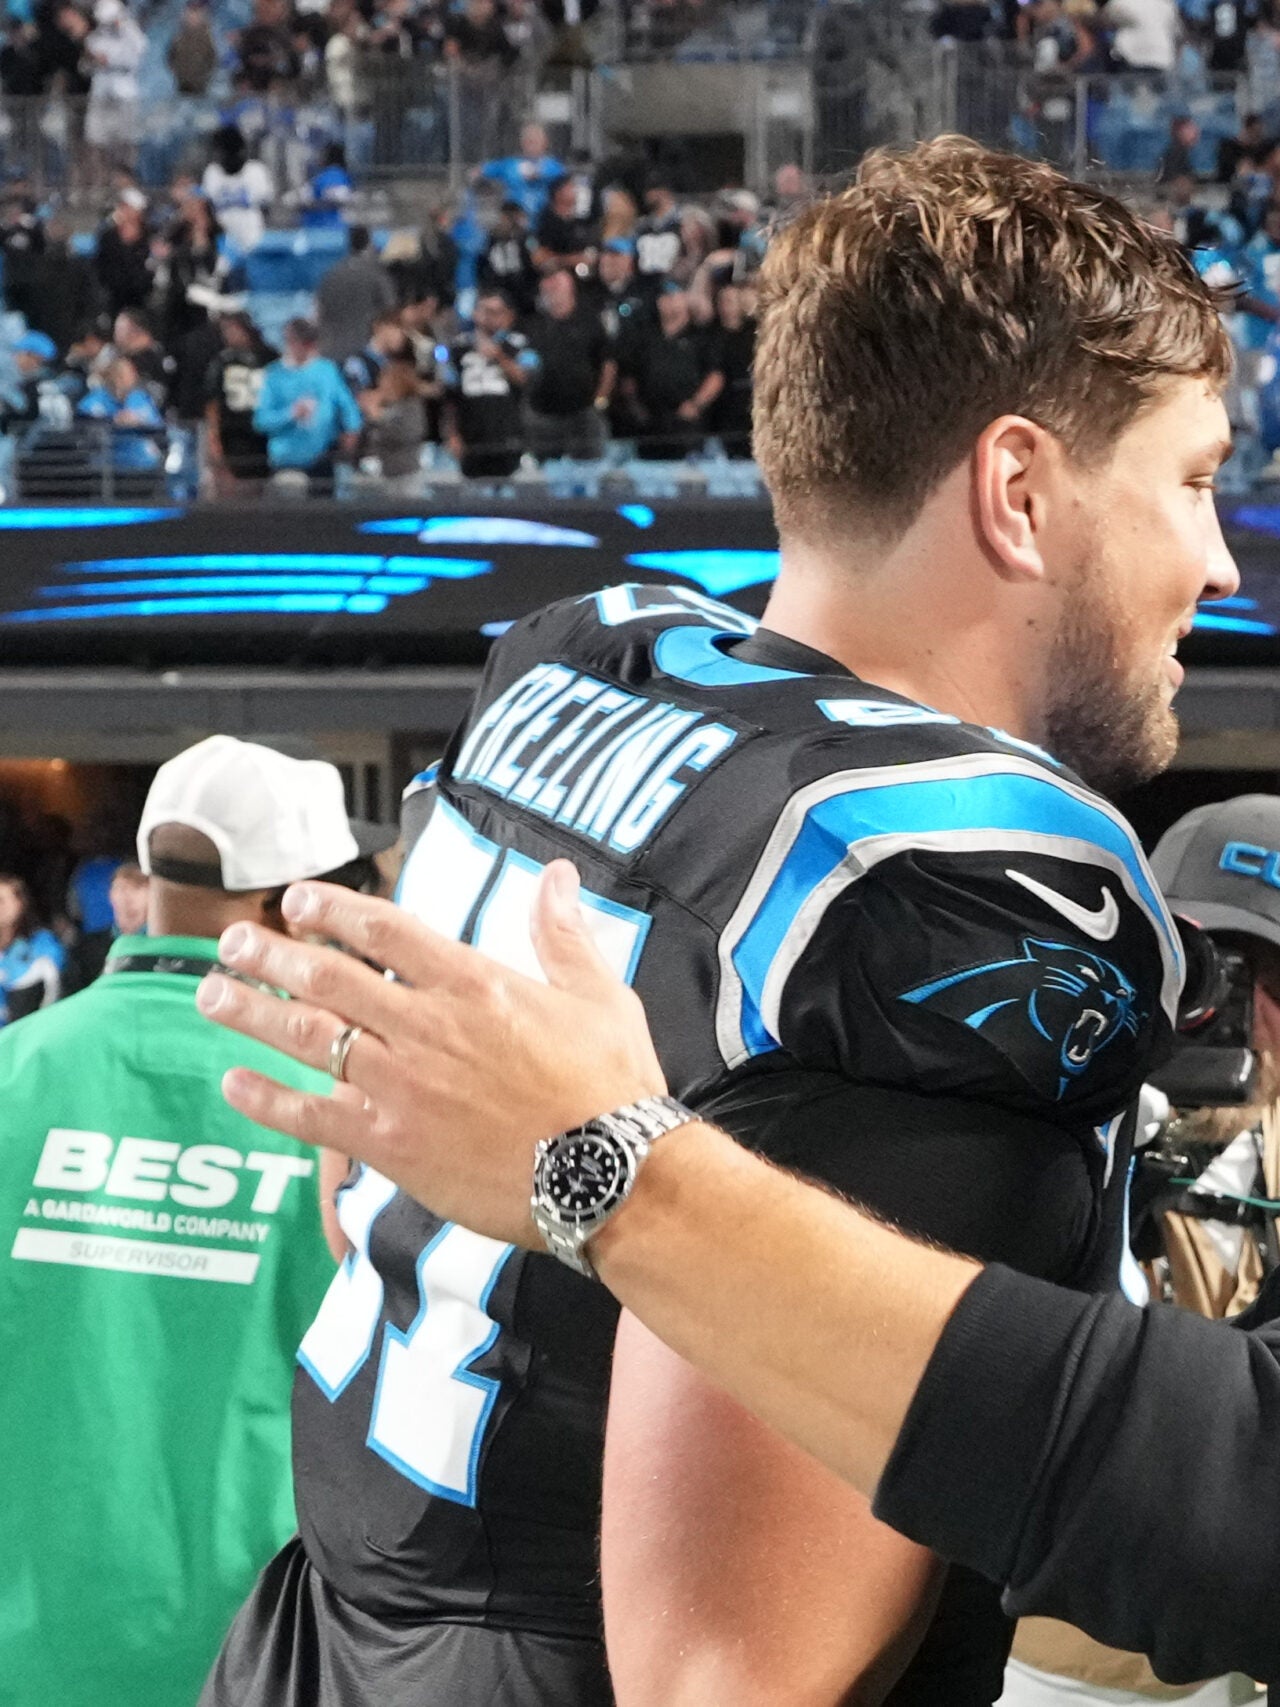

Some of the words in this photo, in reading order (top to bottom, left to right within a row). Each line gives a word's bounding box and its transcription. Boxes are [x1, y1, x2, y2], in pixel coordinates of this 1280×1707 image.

[451, 662, 739, 854] FREELING
[32, 1128, 314, 1214] BEST
[23, 1199, 41, 1217] A
[42, 1199, 172, 1233] GARDAWORLD
[174, 1214, 271, 1242] COMPANY
[69, 1240, 209, 1271] SUPERVISOR
